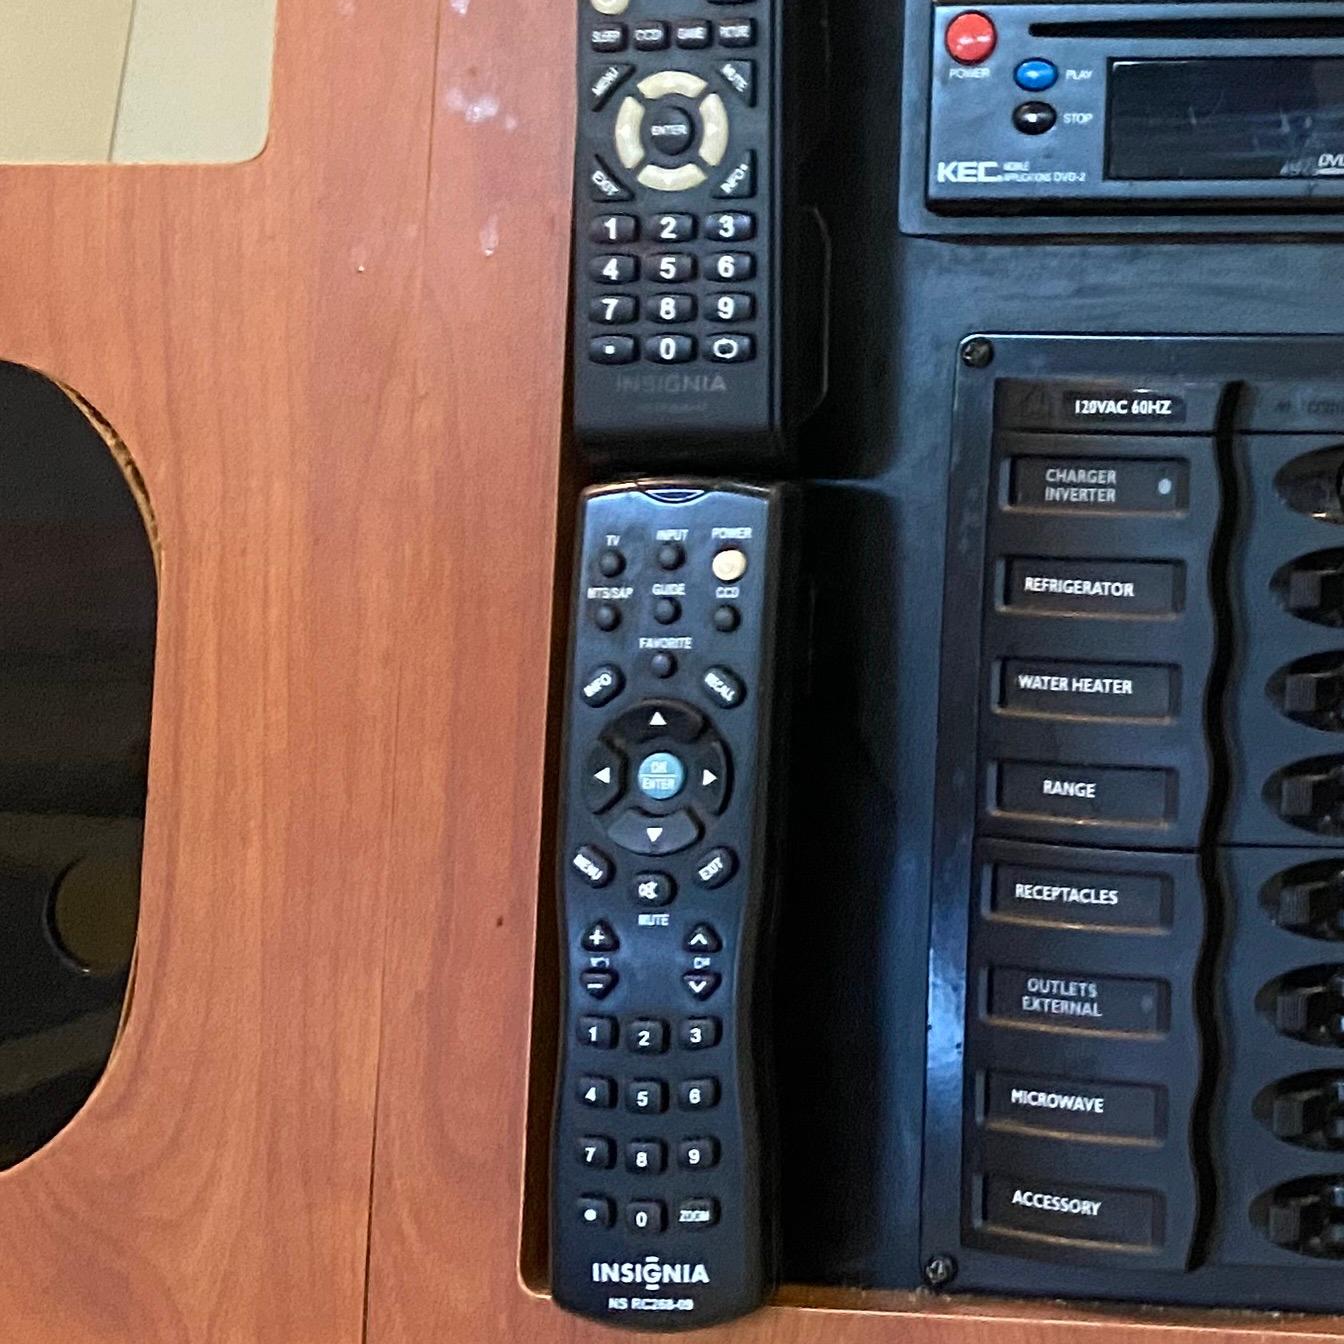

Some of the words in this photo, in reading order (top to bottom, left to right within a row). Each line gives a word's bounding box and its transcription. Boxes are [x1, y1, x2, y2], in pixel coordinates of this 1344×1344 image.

[950, 68, 990, 79] POWER
[1065, 70, 1092, 81] PLAY
[1064, 113, 1093, 124] STOP
[937, 161, 1000, 183] KEC
[604, 218, 616, 240] 1
[660, 217, 677, 239] 2
[718, 215, 735, 238] 3
[603, 258, 618, 280] 4
[660, 258, 676, 279] 5
[718, 256, 734, 278] 6
[601, 298, 618, 320] 7
[660, 298, 676, 320] 8
[718, 297, 734, 319] 9
[660, 338, 676, 360] 0
[1074, 400, 1129, 416] 120VAC
[1131, 400, 1171, 416] 60HZ
[1045, 469, 1117, 485] CHARGER
[1045, 487, 1116, 503] INVERTER
[1024, 577, 1134, 598] REFRIGERATOR
[1018, 675, 1069, 692] WATER
[1071, 677, 1133, 695] HEATER
[1043, 780, 1096, 799] RANGE
[1015, 883, 1119, 906] RECEPTACLES
[1027, 978, 1098, 999] OUTLETS
[1022, 996, 1103, 1017] EXTERNAL
[1011, 1088, 1104, 1113] MICROWAVE
[1012, 1189, 1101, 1216] ACCESSORY
[592, 1257, 710, 1290] INSIGNIA
